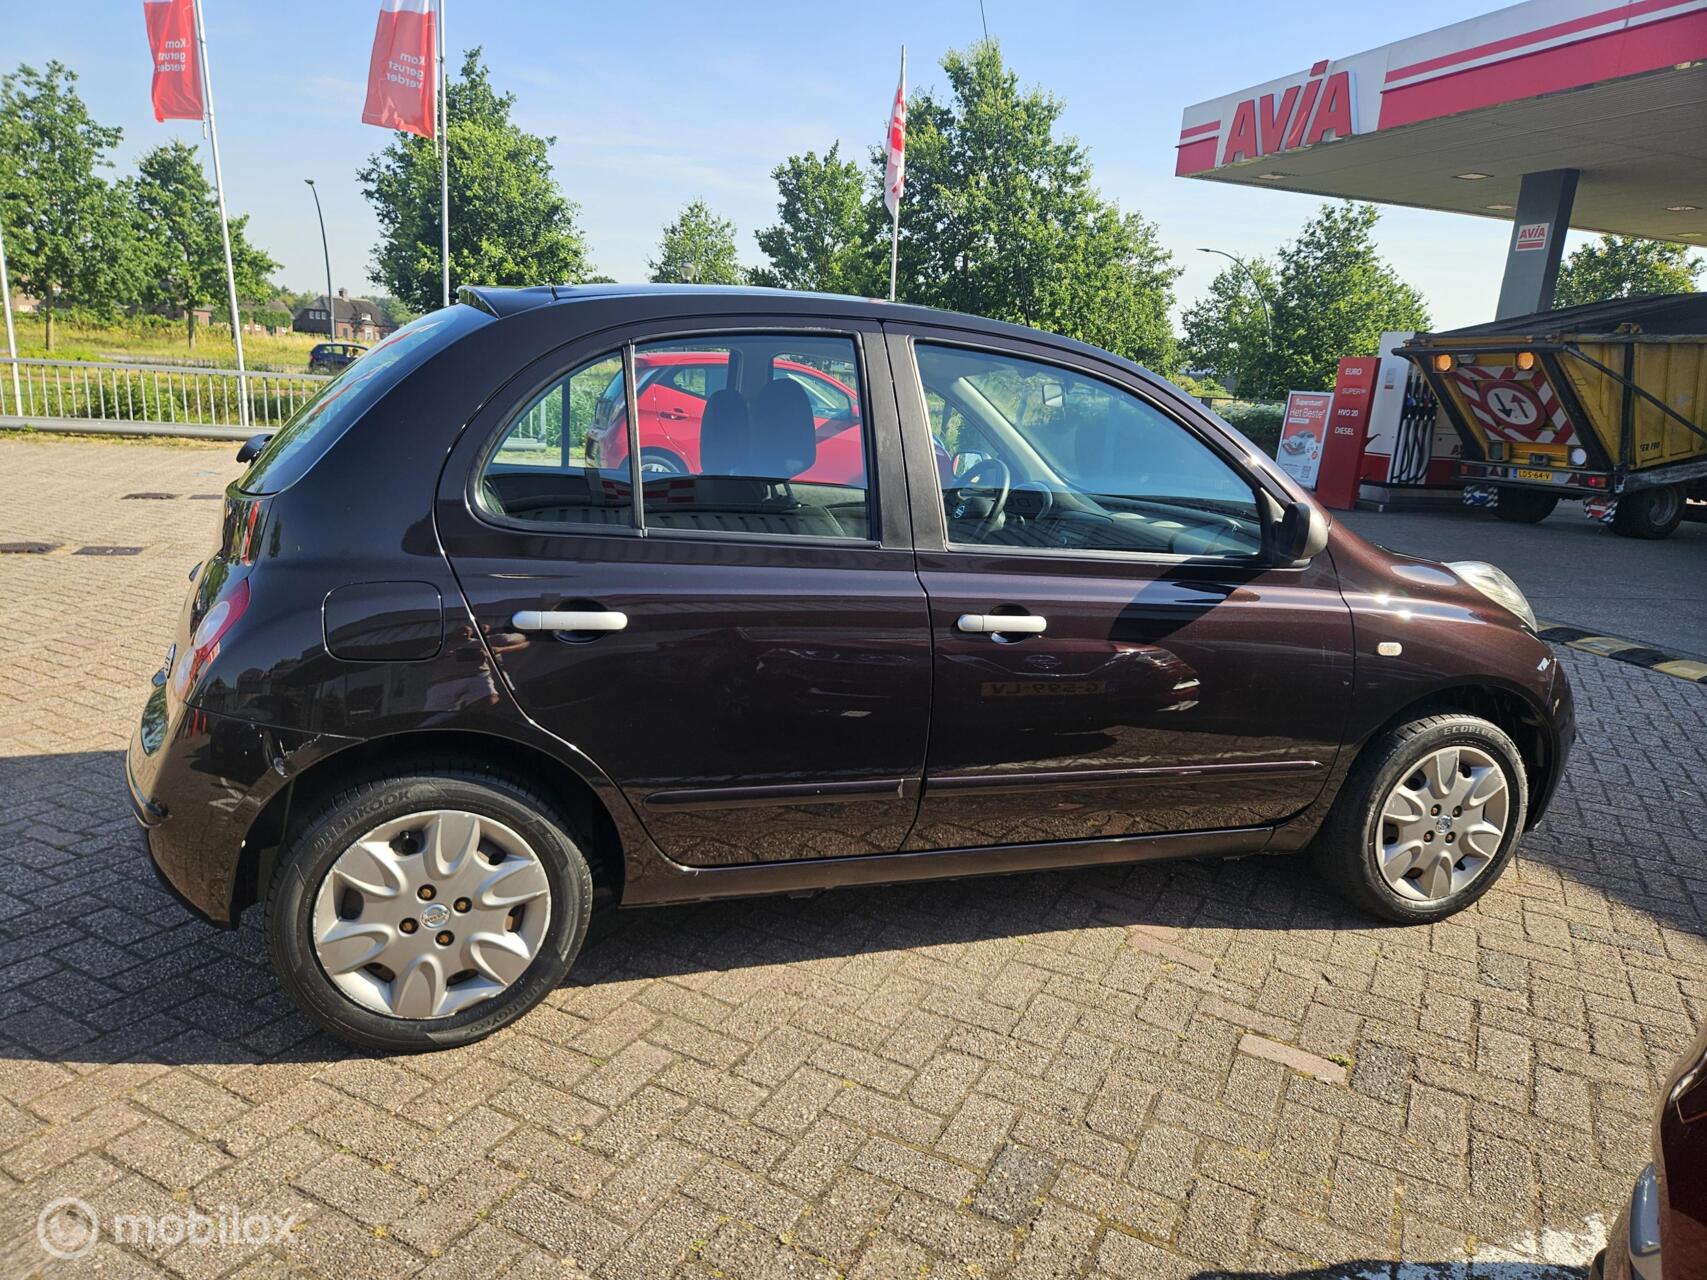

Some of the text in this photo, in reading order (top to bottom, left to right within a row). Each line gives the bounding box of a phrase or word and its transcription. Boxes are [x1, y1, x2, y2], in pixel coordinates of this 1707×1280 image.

[1222, 59, 1352, 165] AVIA
[1520, 225, 1546, 239] AVIA
[1345, 367, 1362, 375] EURO
[1338, 408, 1350, 416] HVO
[1334, 426, 1354, 436] DIESEL
